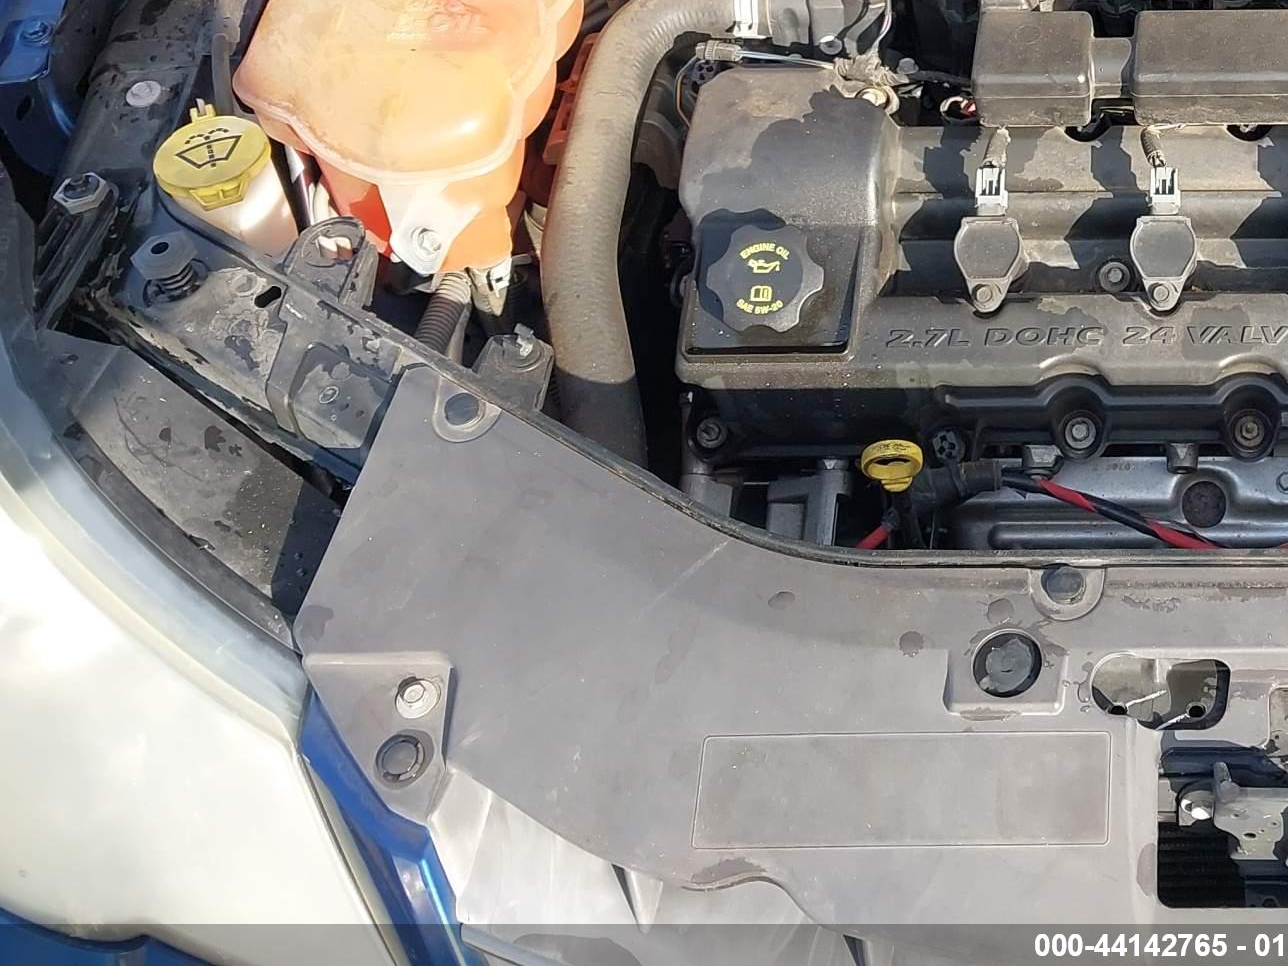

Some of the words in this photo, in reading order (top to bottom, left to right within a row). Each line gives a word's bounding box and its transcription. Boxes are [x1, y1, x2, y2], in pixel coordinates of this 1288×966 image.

[739, 242, 776, 260] ENGINE
[775, 245, 790, 260] OIL
[736, 298, 753, 313] SAE
[754, 299, 784, 315] 5W-20
[884, 327, 972, 348] 2.7L
[983, 326, 1105, 347] DOHC
[1121, 325, 1178, 346] 24
